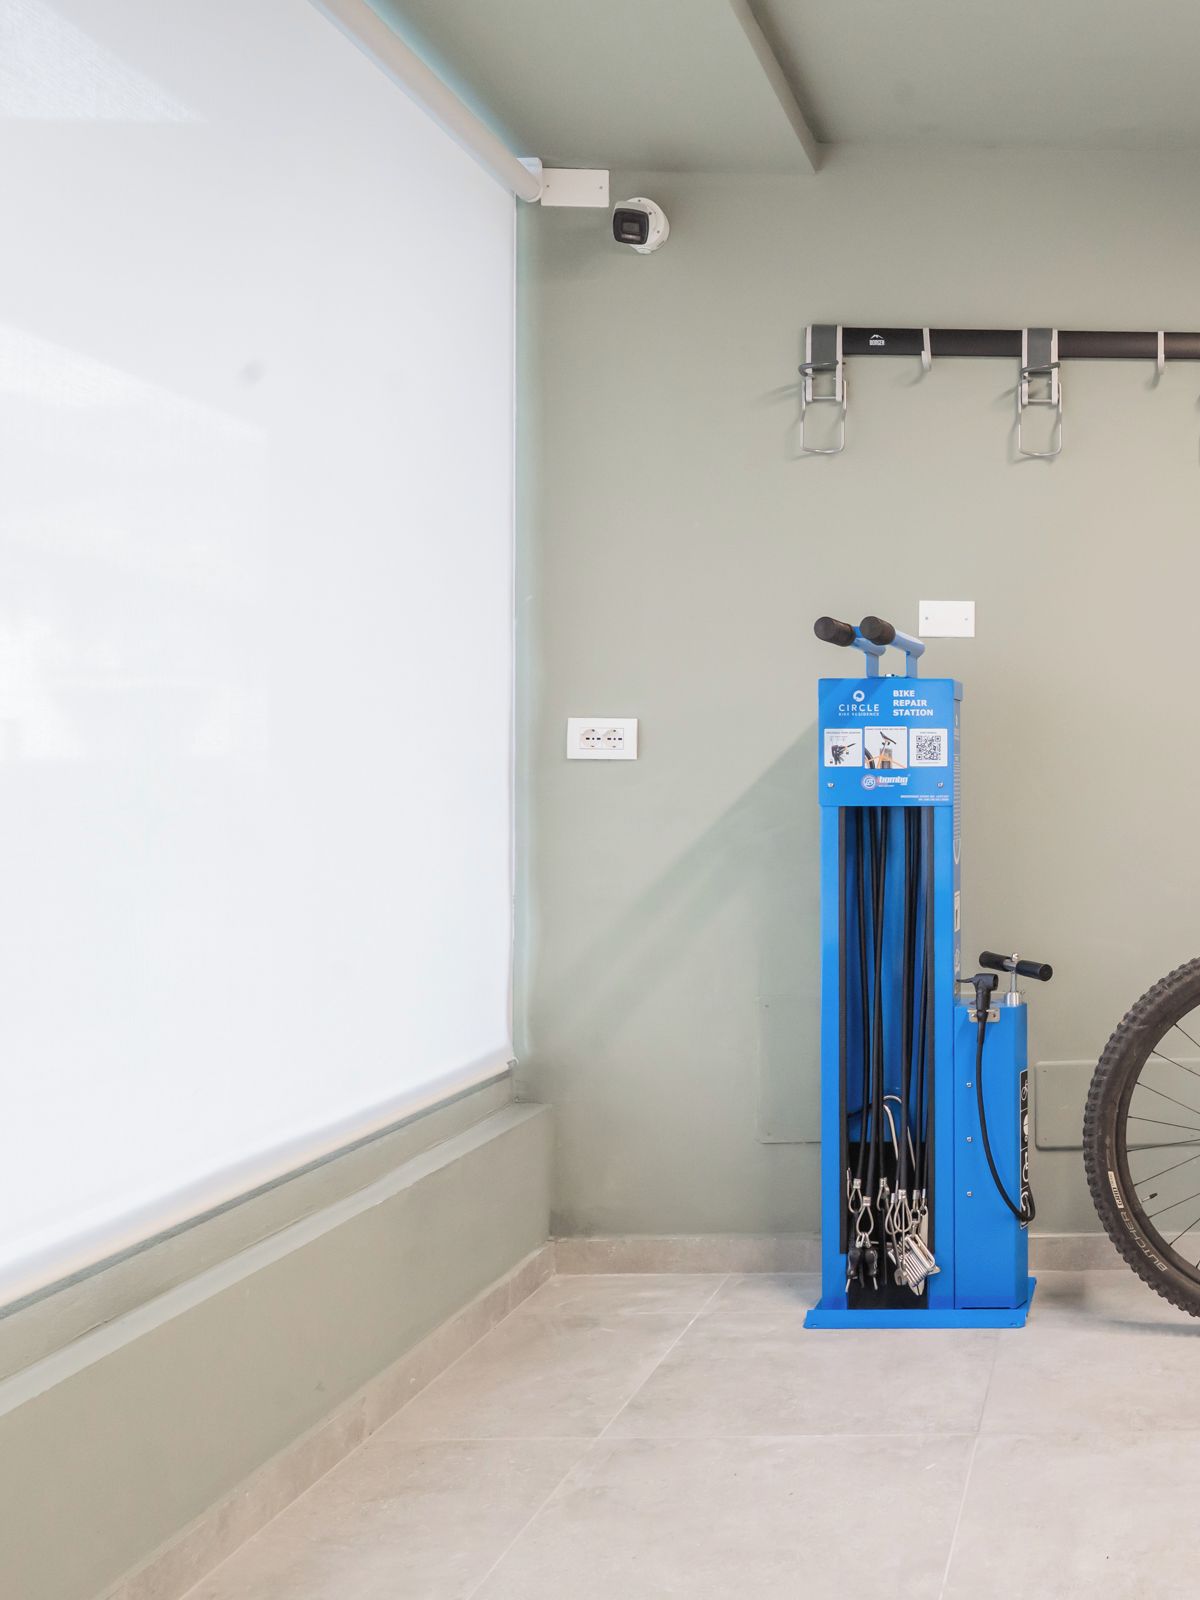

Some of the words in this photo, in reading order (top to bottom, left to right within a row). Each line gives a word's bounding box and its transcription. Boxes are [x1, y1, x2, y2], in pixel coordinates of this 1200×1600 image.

[893, 699, 927, 707] REPAIR
[839, 704, 880, 712] CIRCLE
[893, 709, 933, 717] STATION
[1121, 1211, 1168, 1271] BUTCHER
